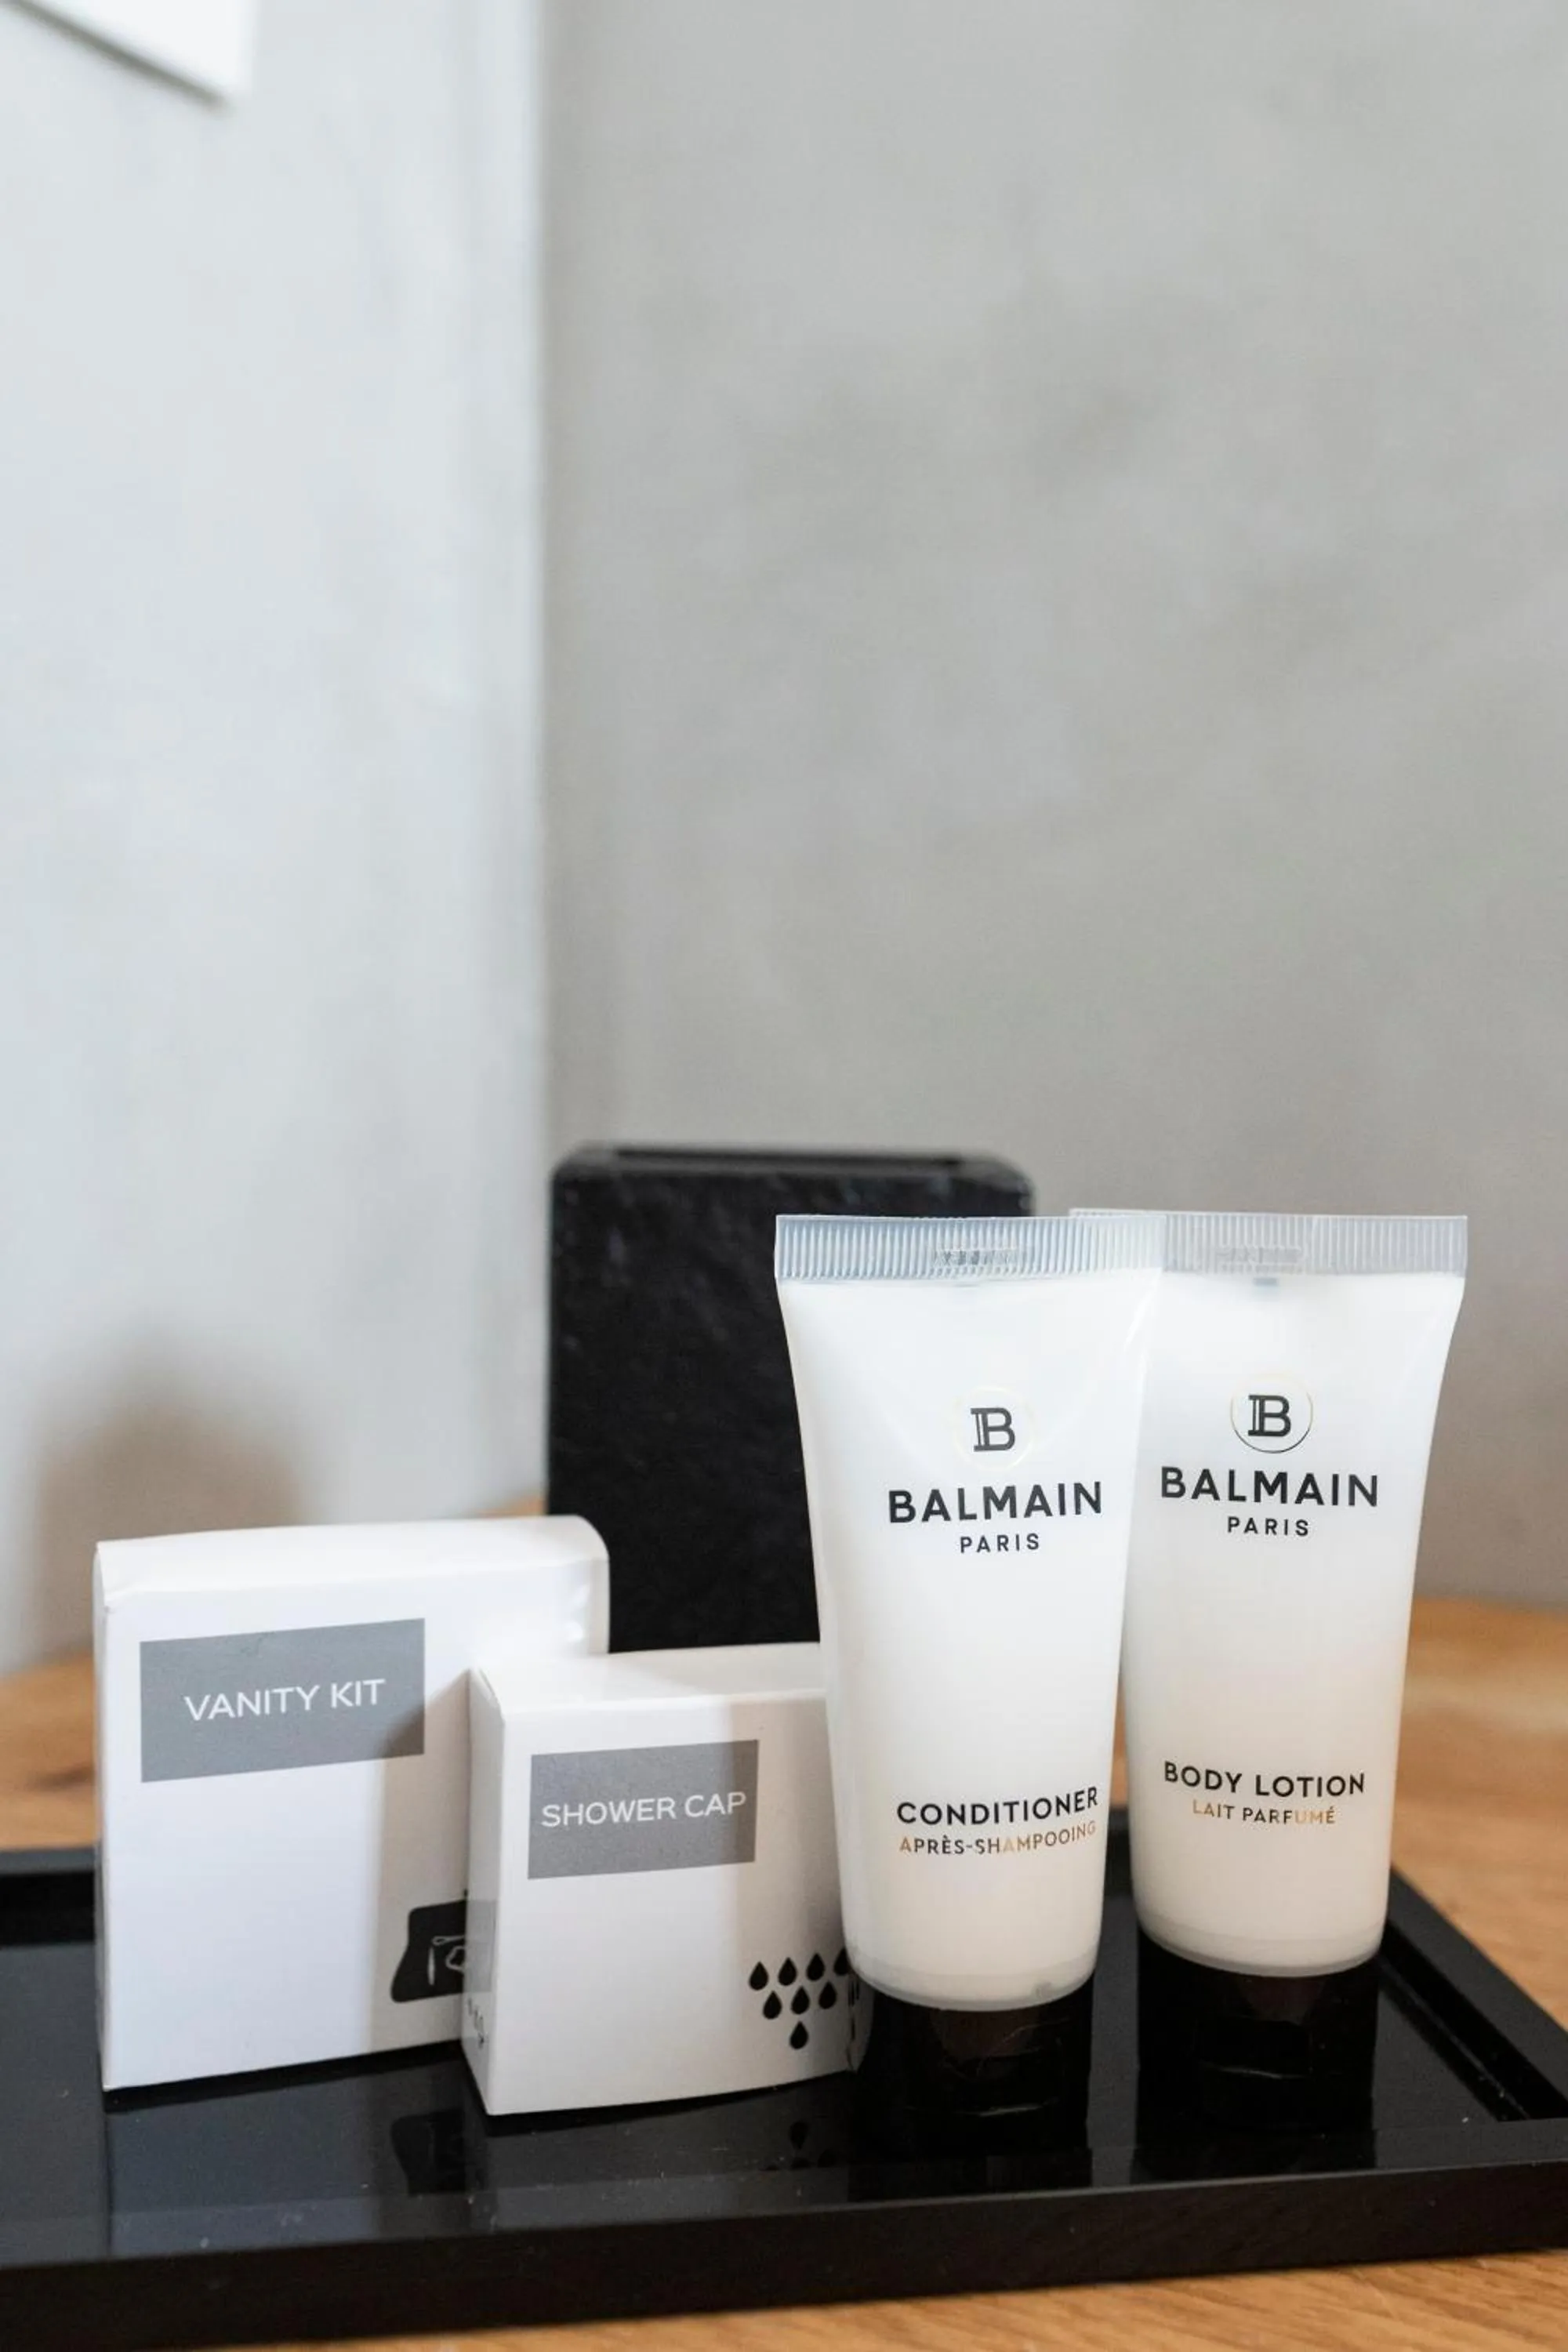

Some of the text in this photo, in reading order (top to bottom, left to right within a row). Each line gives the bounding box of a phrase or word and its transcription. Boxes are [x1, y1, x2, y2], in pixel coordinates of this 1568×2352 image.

[888, 1481, 1102, 1523] BALMAIN
[1160, 1465, 1378, 1508] BALMAIN
[959, 1532, 1040, 1554] PARIS
[1227, 1515, 1309, 1537] PARIS
[183, 1679, 386, 1721] VANITY KIT
[1163, 1761, 1365, 1798] BODY LOTION
[541, 1791, 746, 1828] SHOWER CAP
[896, 1785, 1098, 1826] CONDITIONER
[1192, 1799, 1336, 1825] LAIT PARFUMÉ
[899, 1821, 1097, 1855] APRÈS-SHAMPOOING
